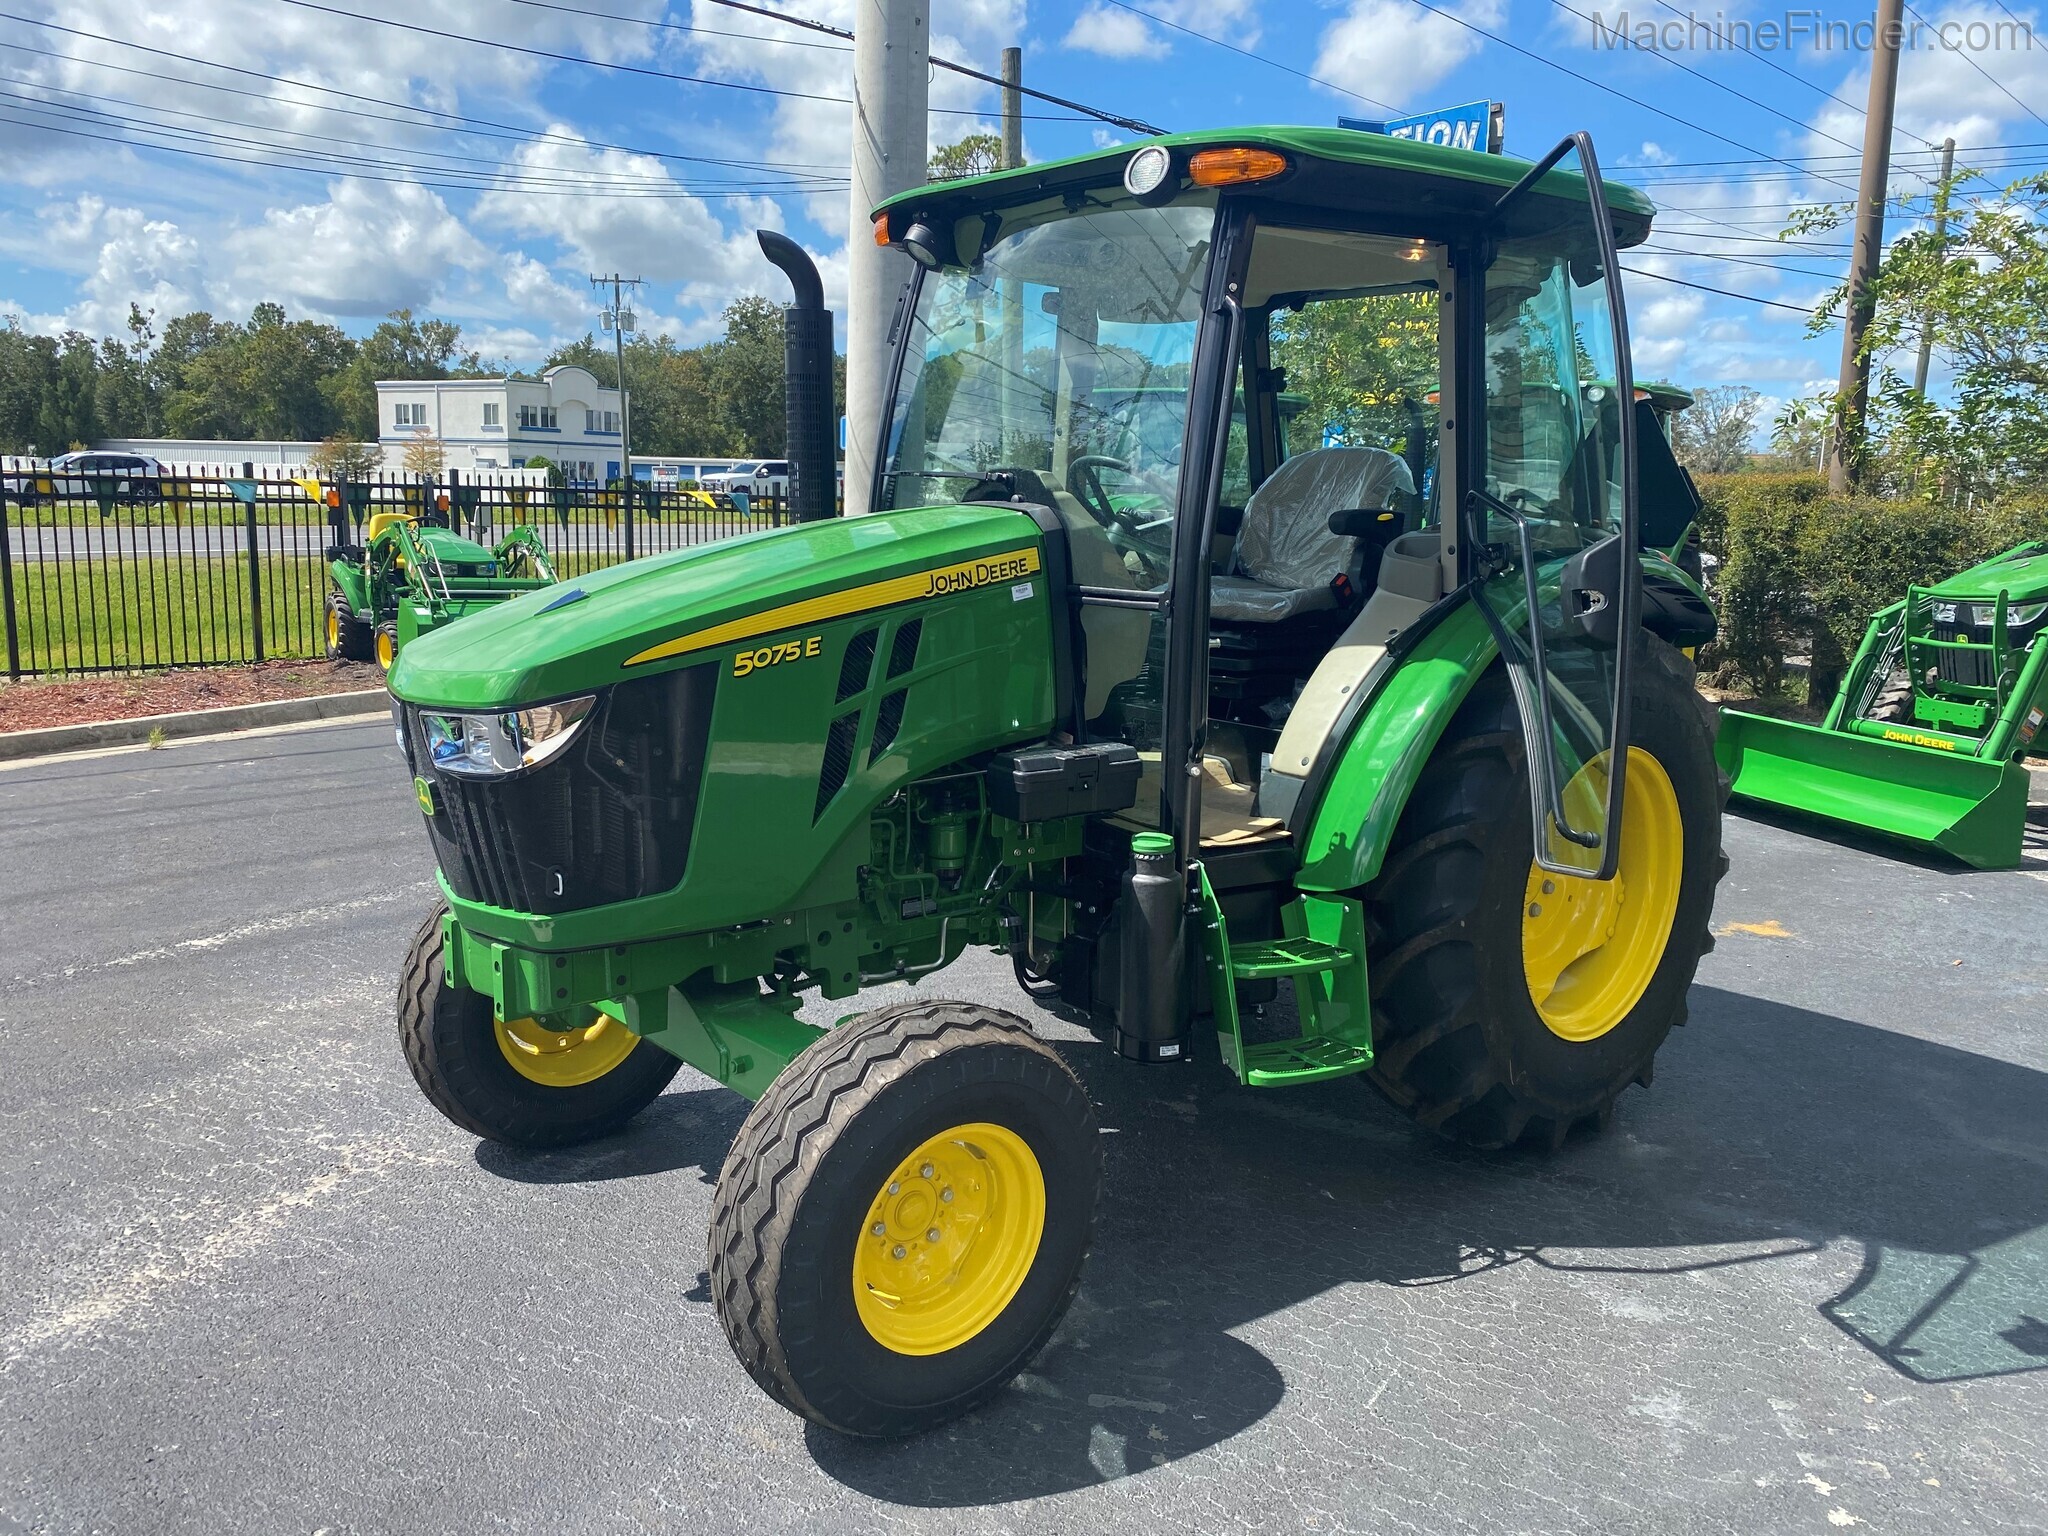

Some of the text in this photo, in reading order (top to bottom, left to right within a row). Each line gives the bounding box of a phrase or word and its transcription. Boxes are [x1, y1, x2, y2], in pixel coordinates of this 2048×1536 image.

[925, 558, 1029, 595] JOHN DEERE
[733, 635, 822, 677] 5075 E
[1882, 729, 1955, 750] JOHN DEERE
